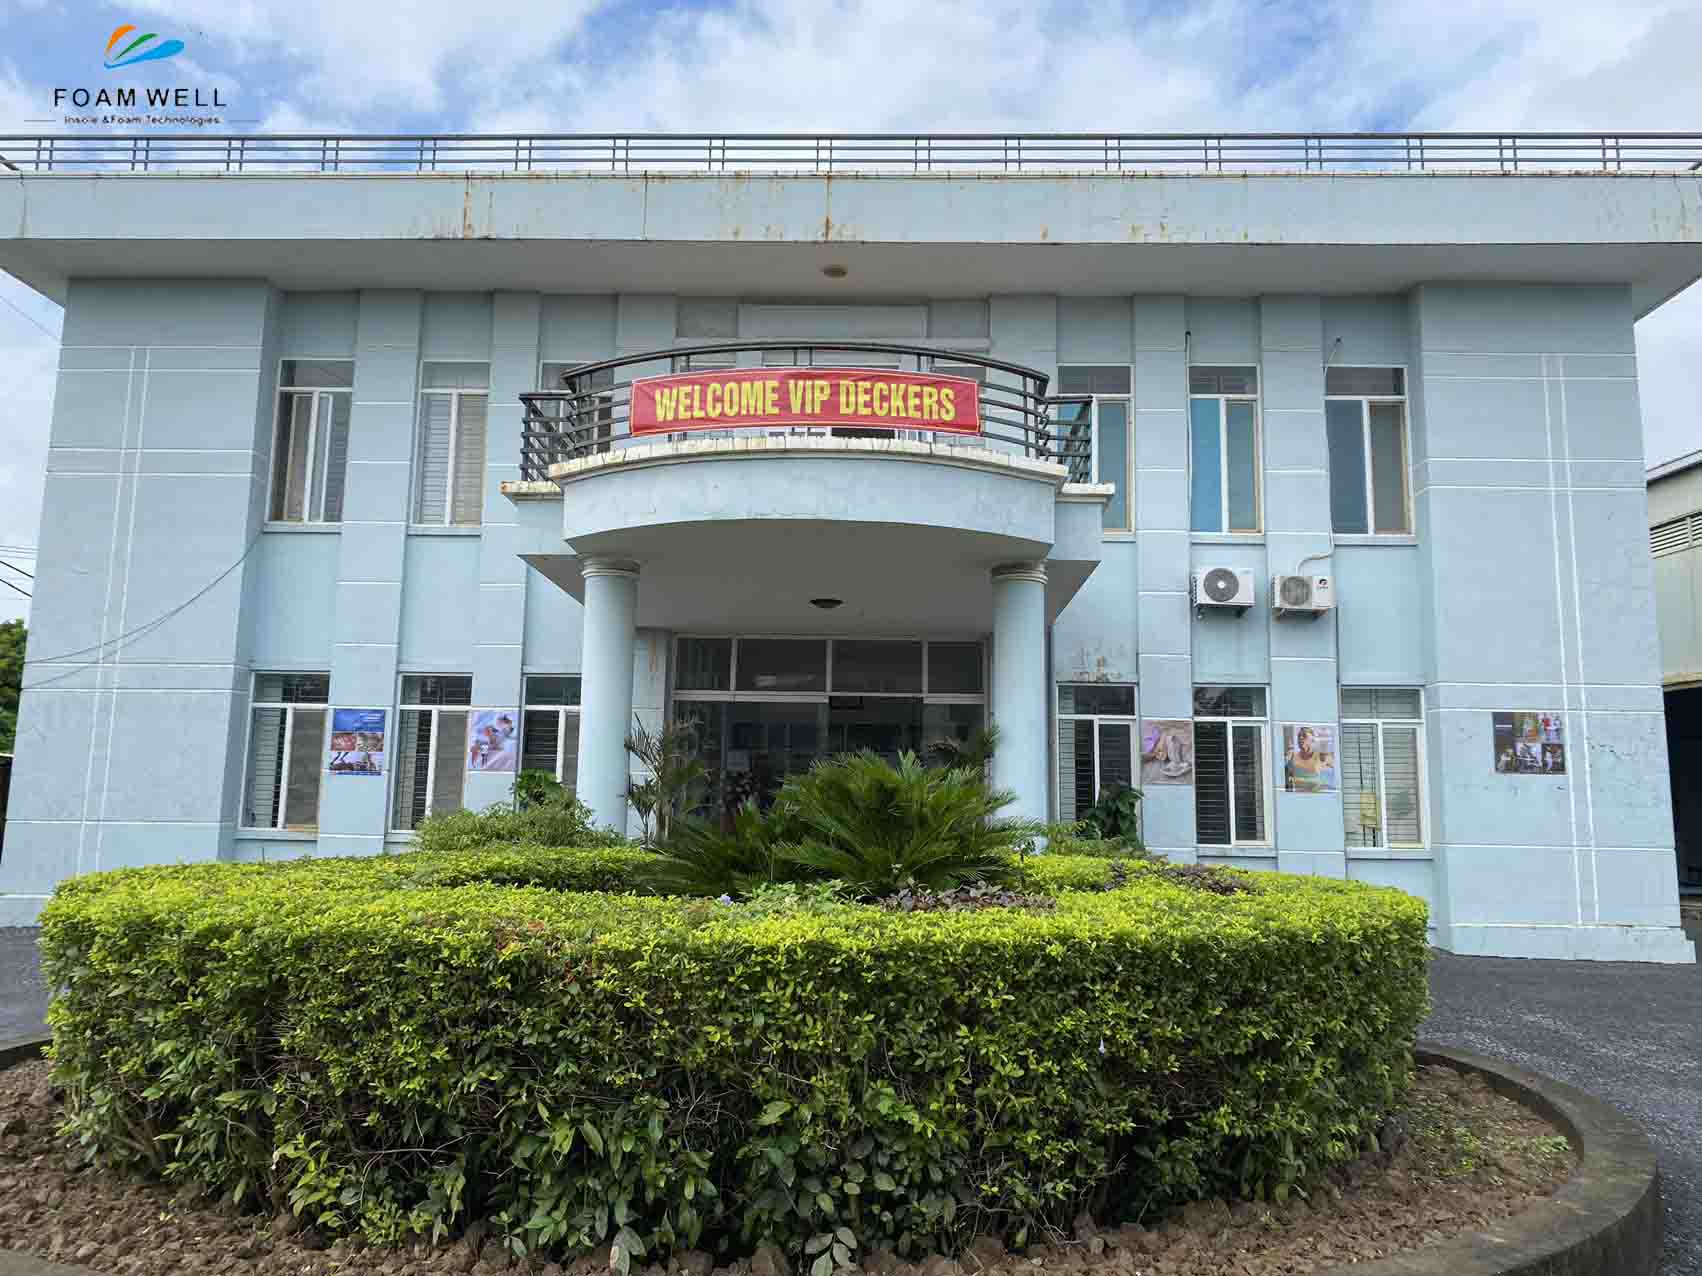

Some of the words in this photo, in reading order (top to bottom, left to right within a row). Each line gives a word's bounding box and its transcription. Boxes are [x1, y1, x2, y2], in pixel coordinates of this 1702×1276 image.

[654, 380, 780, 422] WELCOME
[788, 379, 831, 415] VIP
[839, 381, 956, 422] DECKERS
